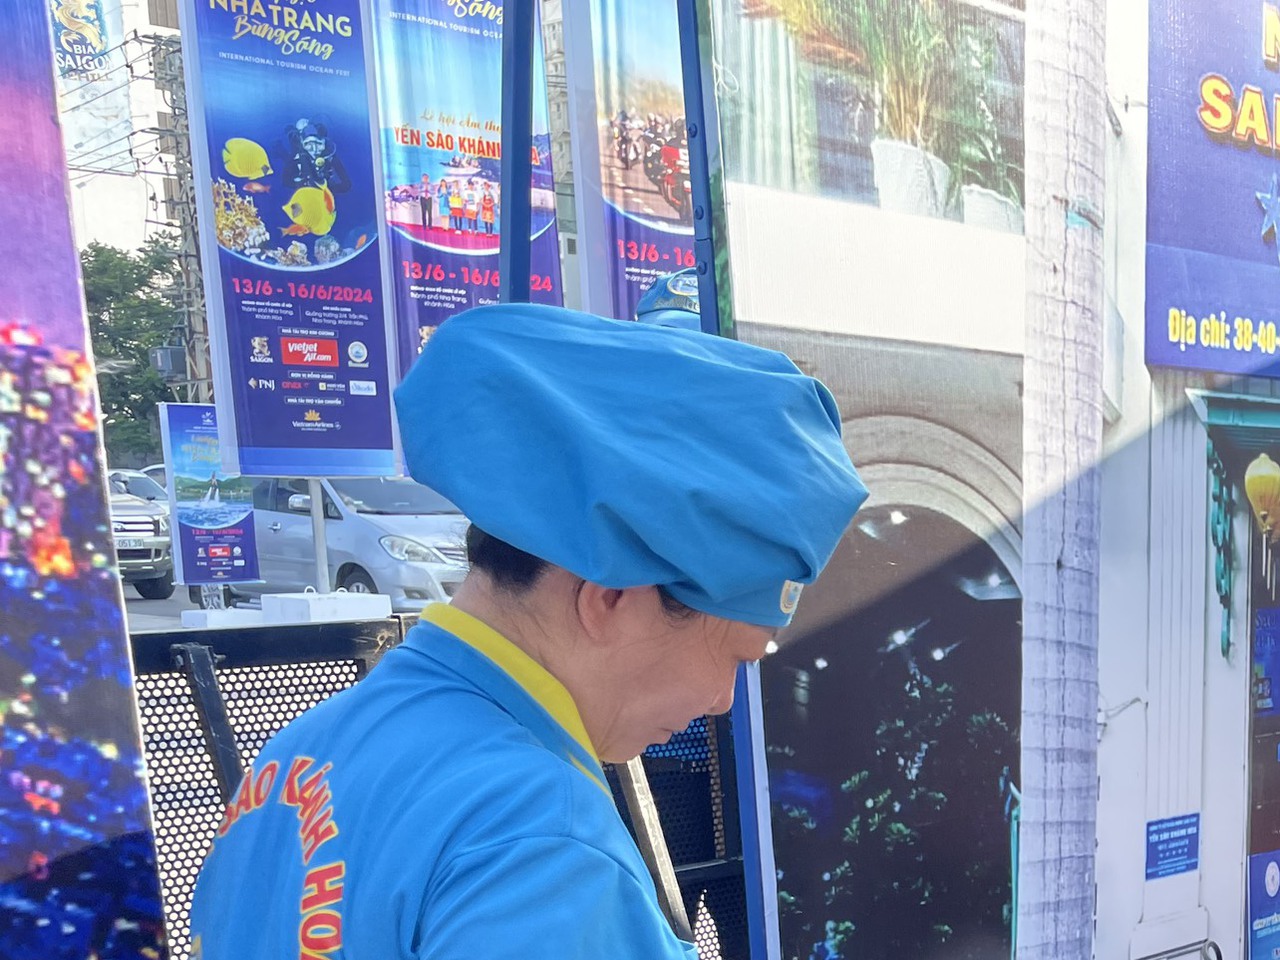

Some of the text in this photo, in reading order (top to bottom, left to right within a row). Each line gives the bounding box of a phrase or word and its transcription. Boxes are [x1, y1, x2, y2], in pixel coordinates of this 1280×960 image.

[268, 5, 352, 37] TRANG
[389, 12, 448, 29] INTERNATIONAL
[450, 23, 480, 35] TOURISM
[73, 44, 95, 54] BIA
[219, 52, 275, 66] INTERNATIONAL
[276, 60, 307, 71] TOURISM
[309, 65, 334, 74] OCEAN
[394, 122, 421, 146] YẾN
[426, 126, 454, 151] SÀO
[617, 239, 659, 262] 13/6
[402, 261, 445, 281] 13/6
[232, 278, 272, 296] 13/6
[288, 282, 373, 303] 16/6/2024
[1168, 307, 1196, 351] Địa
[1200, 311, 1230, 349] chỉ:
[258, 379, 275, 391] PNJ
